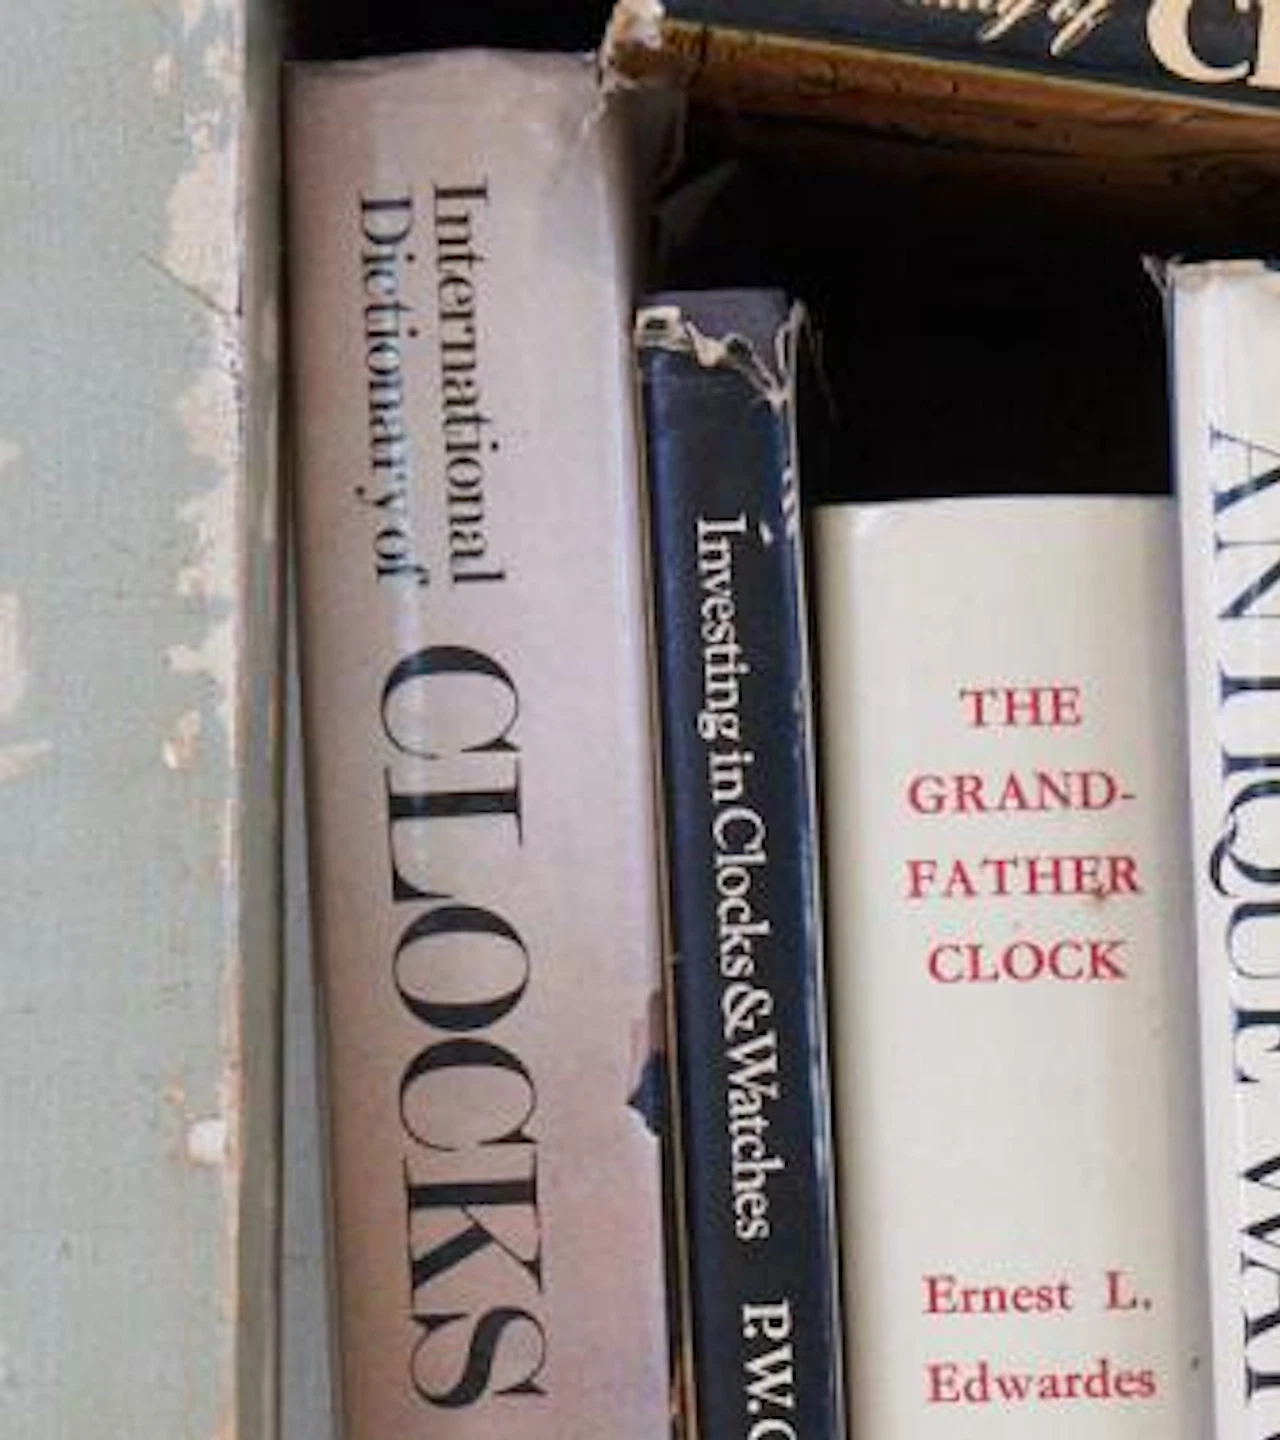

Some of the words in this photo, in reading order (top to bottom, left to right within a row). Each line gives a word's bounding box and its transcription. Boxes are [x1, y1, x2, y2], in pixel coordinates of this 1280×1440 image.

[356, 194, 415, 512] Dictionary
[433, 179, 506, 586] International
[375, 522, 430, 587] of
[697, 514, 751, 741] Investing
[959, 686, 1083, 729] THE
[708, 752, 755, 803] in
[909, 770, 1137, 815] GRAND-
[905, 855, 1142, 898] FATHER
[928, 939, 1130, 984] CLOCK
[380, 645, 549, 1408] CLOCKS
[922, 1274, 1074, 1315] Ernest
[1106, 1270, 1154, 1312] L.
[926, 1358, 1157, 1403] Edwardes
